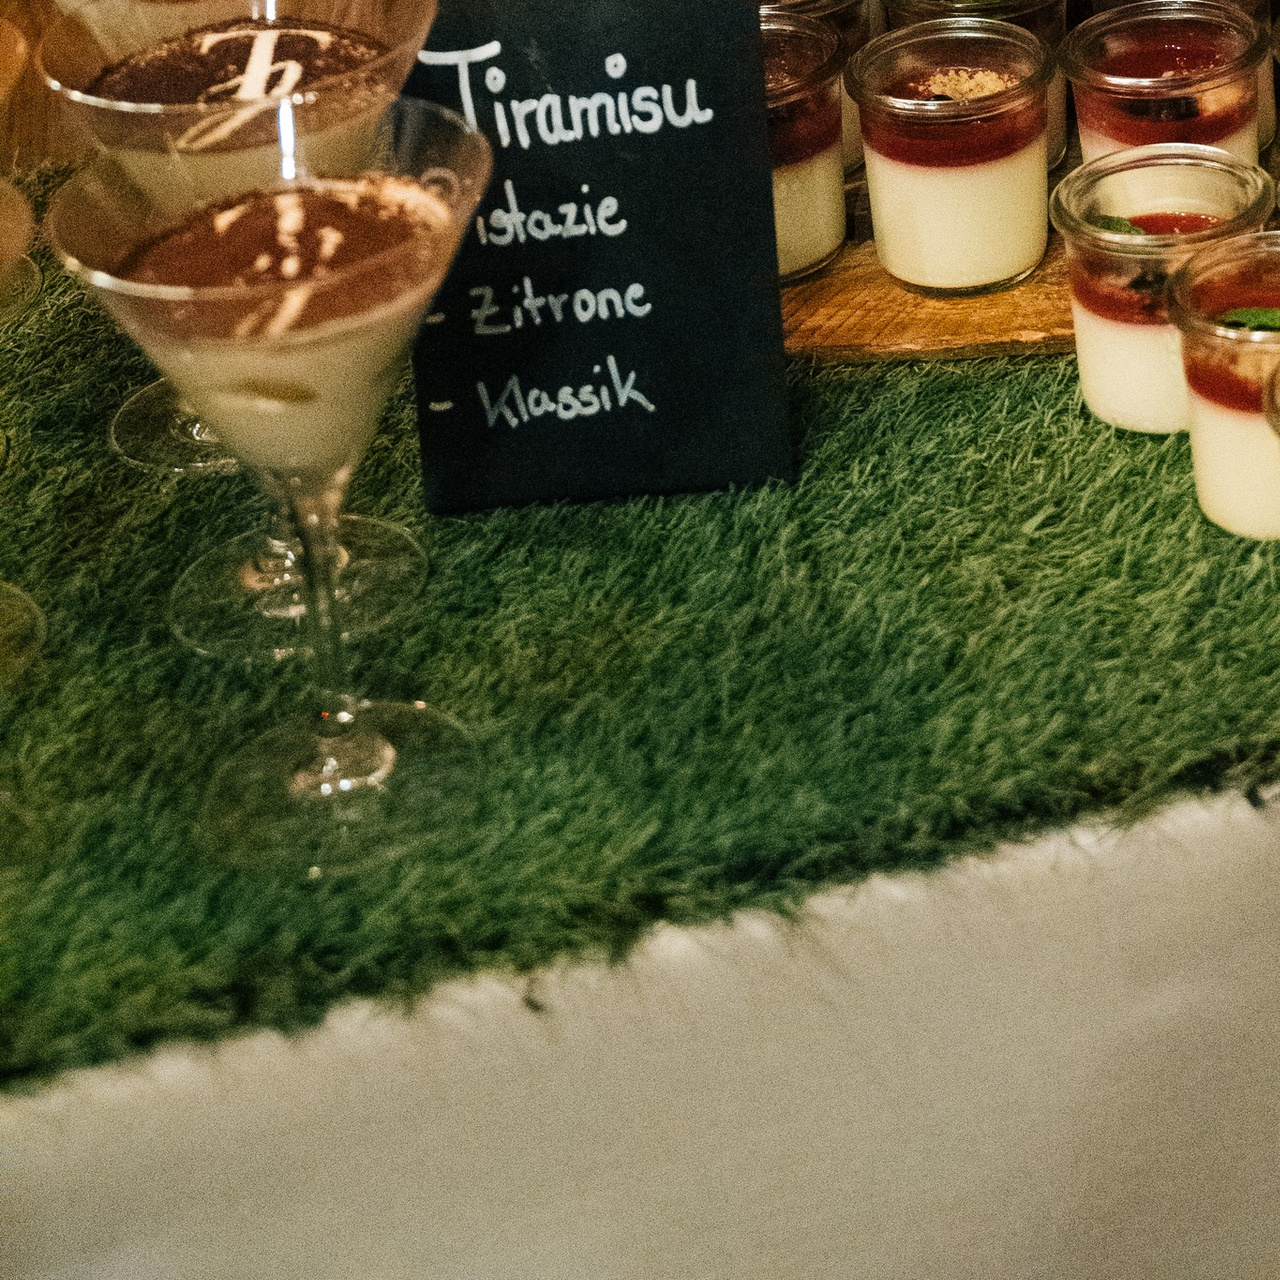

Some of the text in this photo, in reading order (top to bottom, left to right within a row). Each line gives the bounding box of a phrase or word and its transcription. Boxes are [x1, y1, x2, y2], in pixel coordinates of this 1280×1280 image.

[416, 40, 714, 149] Tiramisu
[424, 164, 628, 245] istazie
[469, 276, 653, 334] Zitrone
[476, 354, 656, 429] Klassik
